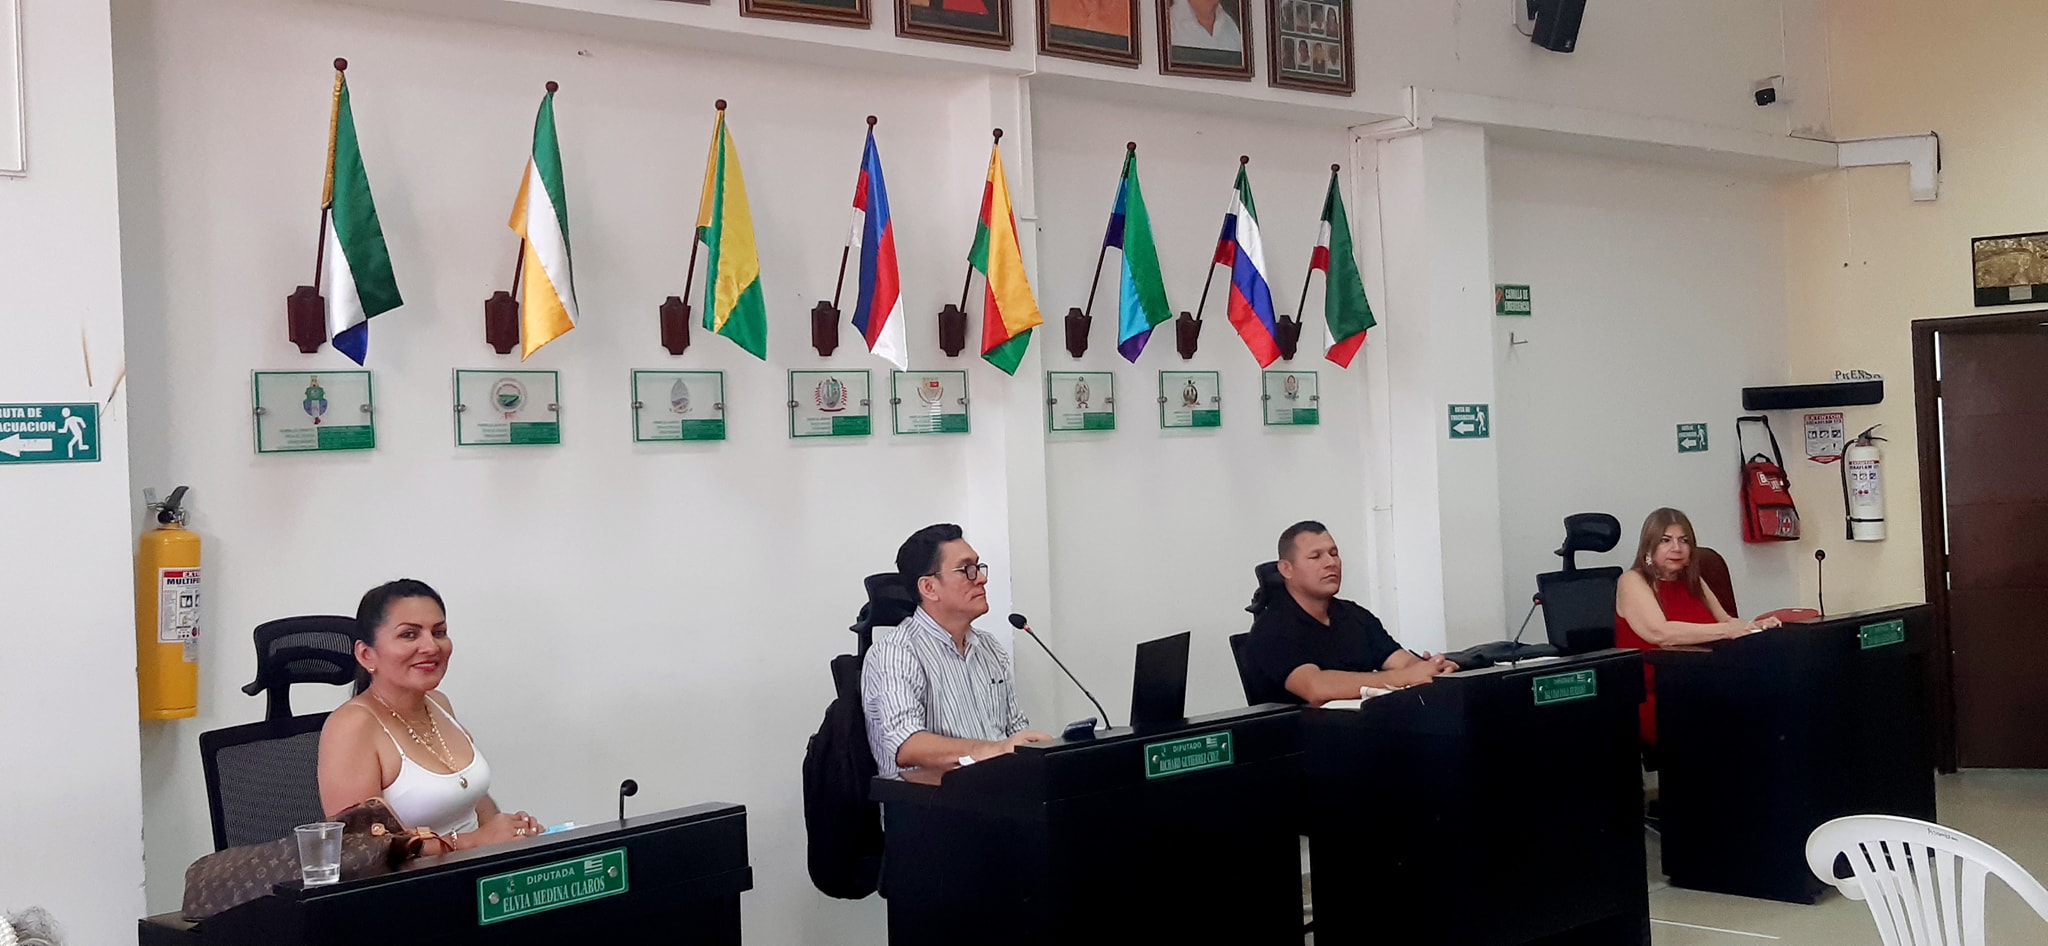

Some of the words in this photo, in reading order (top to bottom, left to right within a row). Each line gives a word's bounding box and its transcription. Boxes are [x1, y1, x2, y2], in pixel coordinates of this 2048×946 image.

[27, 408, 43, 418] DE
[1172, 742, 1202, 753] DIPUTADO
[526, 867, 575, 885] DIPUTADA
[503, 893, 531, 913] ELVIA
[532, 885, 569, 906] MEDINA
[571, 876, 606, 897] CLAROS
